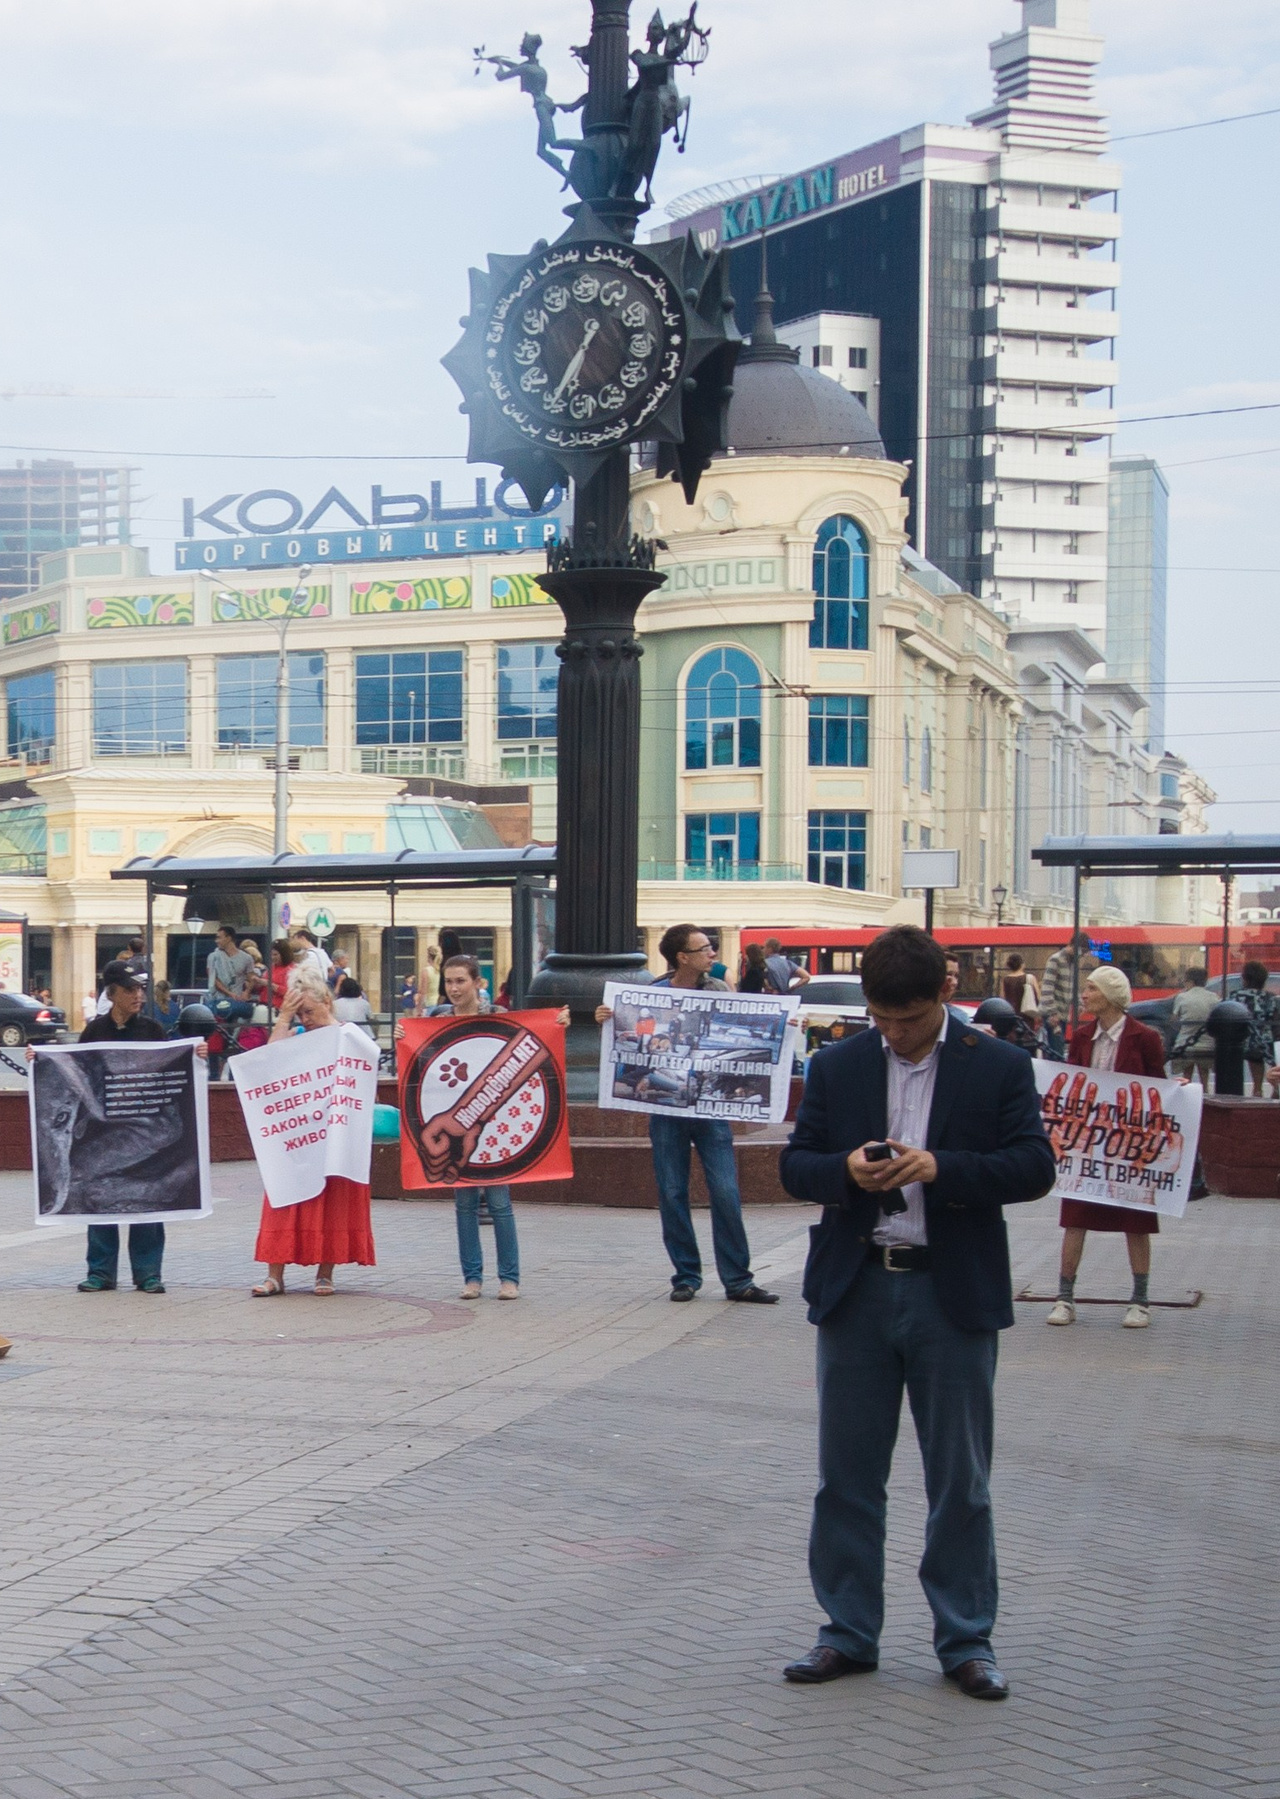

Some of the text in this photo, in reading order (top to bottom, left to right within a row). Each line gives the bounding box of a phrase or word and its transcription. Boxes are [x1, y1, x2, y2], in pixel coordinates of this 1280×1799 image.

[722, 165, 836, 242] KAZAN
[838, 164, 888, 200] HOTEL
[182, 477, 564, 537] КОЛЬЦО
[177, 523, 557, 565] ТОРГОВЫЙ ЦЕНТР
[621, 990, 671, 1008] СОБАКА
[680, 998, 712, 1012] ДРУГ
[670, 1057, 691, 1071] ЕГО
[693, 1058, 772, 1077] ПОСЛЕДНЯЯ
[244, 1071, 313, 1101] ТРЕБУЕМ
[260, 1114, 309, 1138] ЗАКОН
[312, 1110, 324, 1121] О
